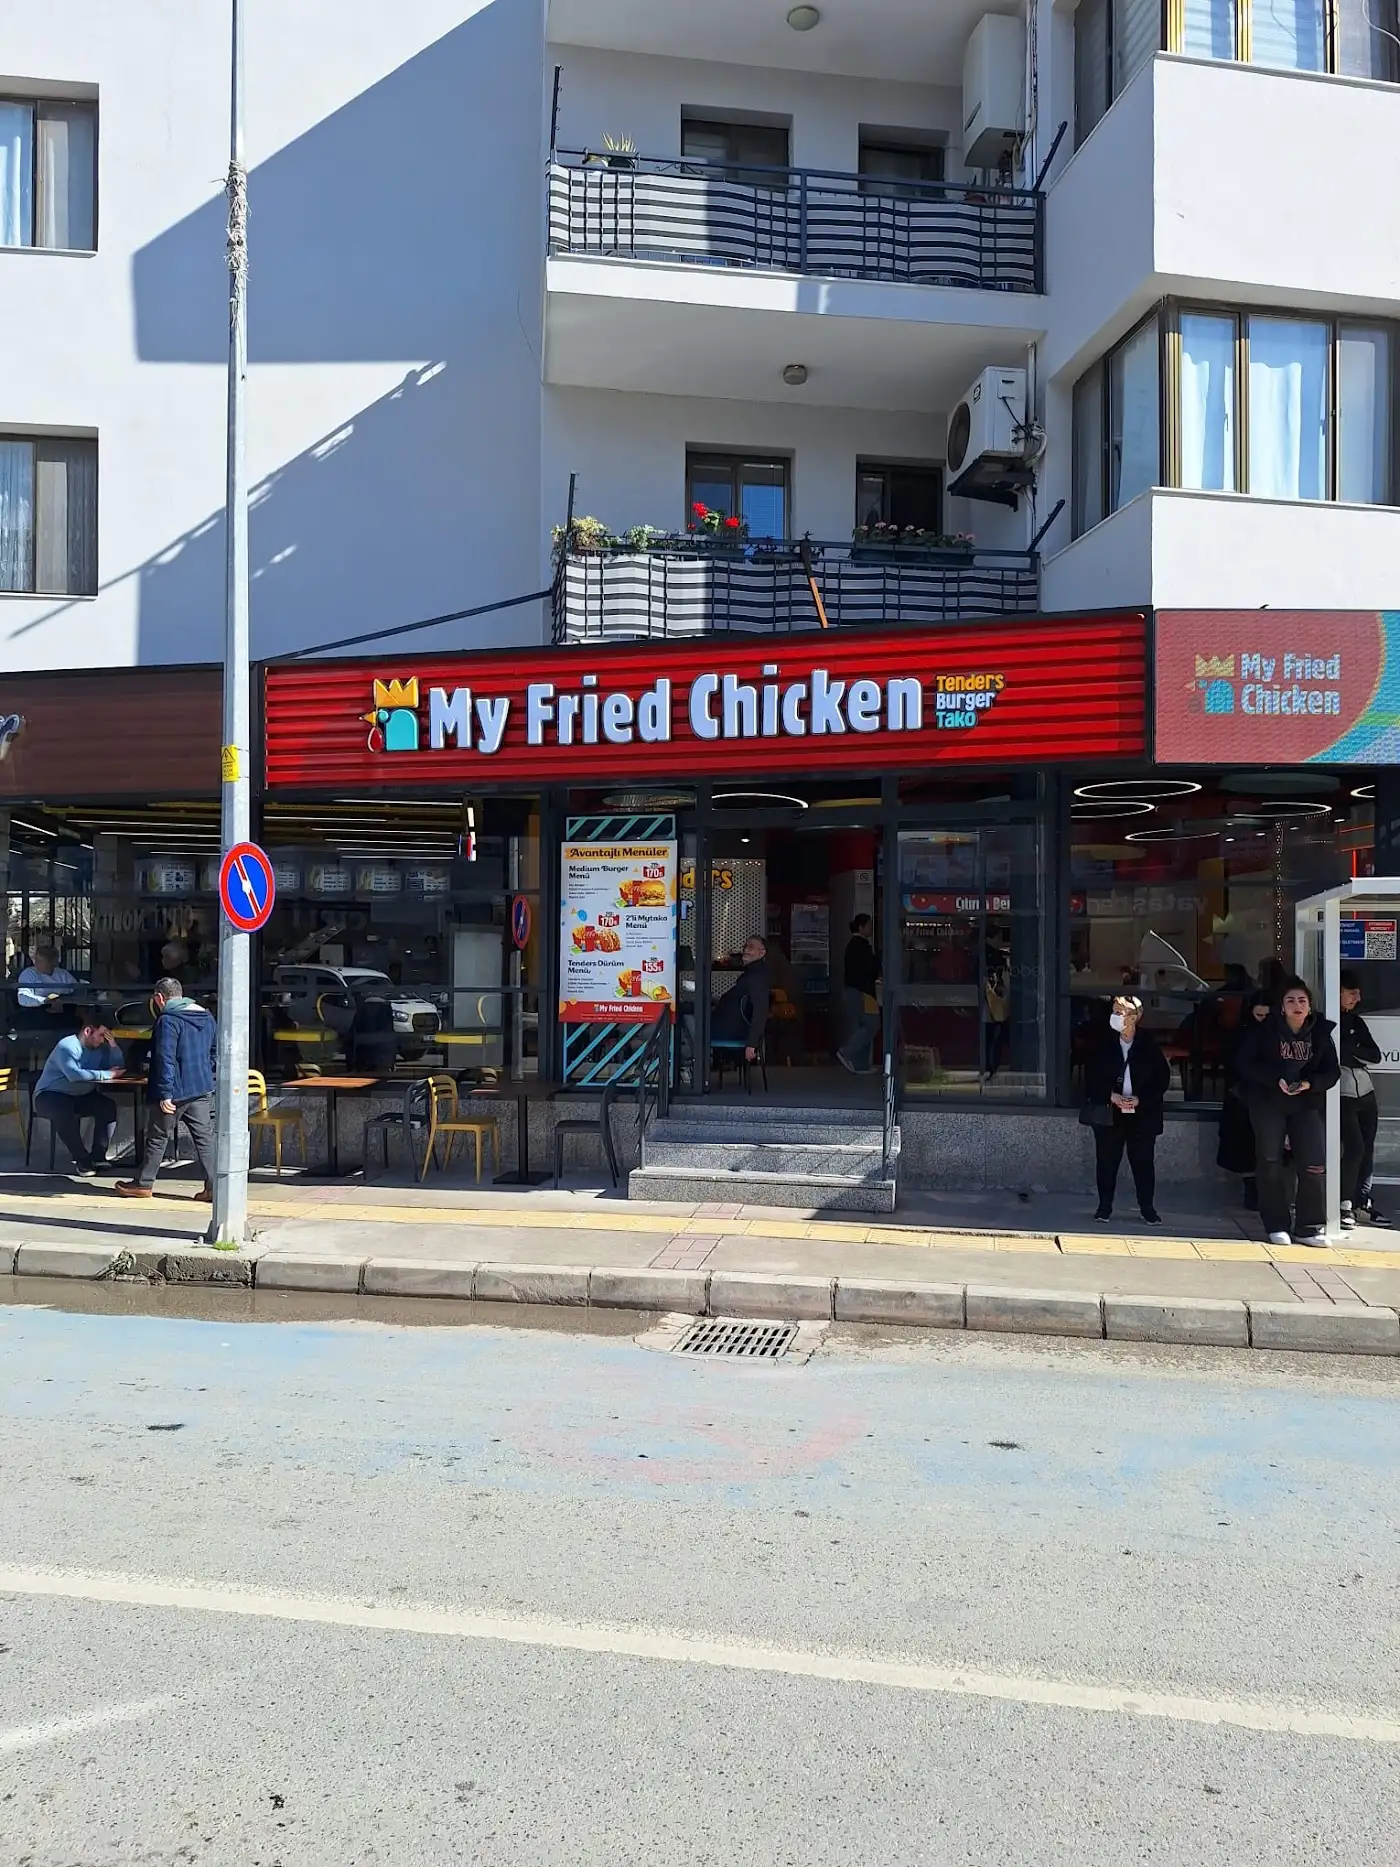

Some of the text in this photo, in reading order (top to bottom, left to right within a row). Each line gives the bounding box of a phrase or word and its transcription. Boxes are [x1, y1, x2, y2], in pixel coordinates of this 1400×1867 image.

[1241, 652, 1341, 681] My Fried
[936, 674, 1005, 692] Tenders
[936, 691, 996, 711] Burger
[1241, 684, 1341, 715] Chicken
[428, 664, 924, 755] My Fried Chicken
[936, 711, 977, 728] Tako
[570, 847, 668, 859] Avantajlı Menüler
[568, 865, 629, 874] Medium Burger
[568, 872, 591, 880] Menü
[599, 1004, 608, 1012] My
[609, 1004, 623, 1012] Fried
